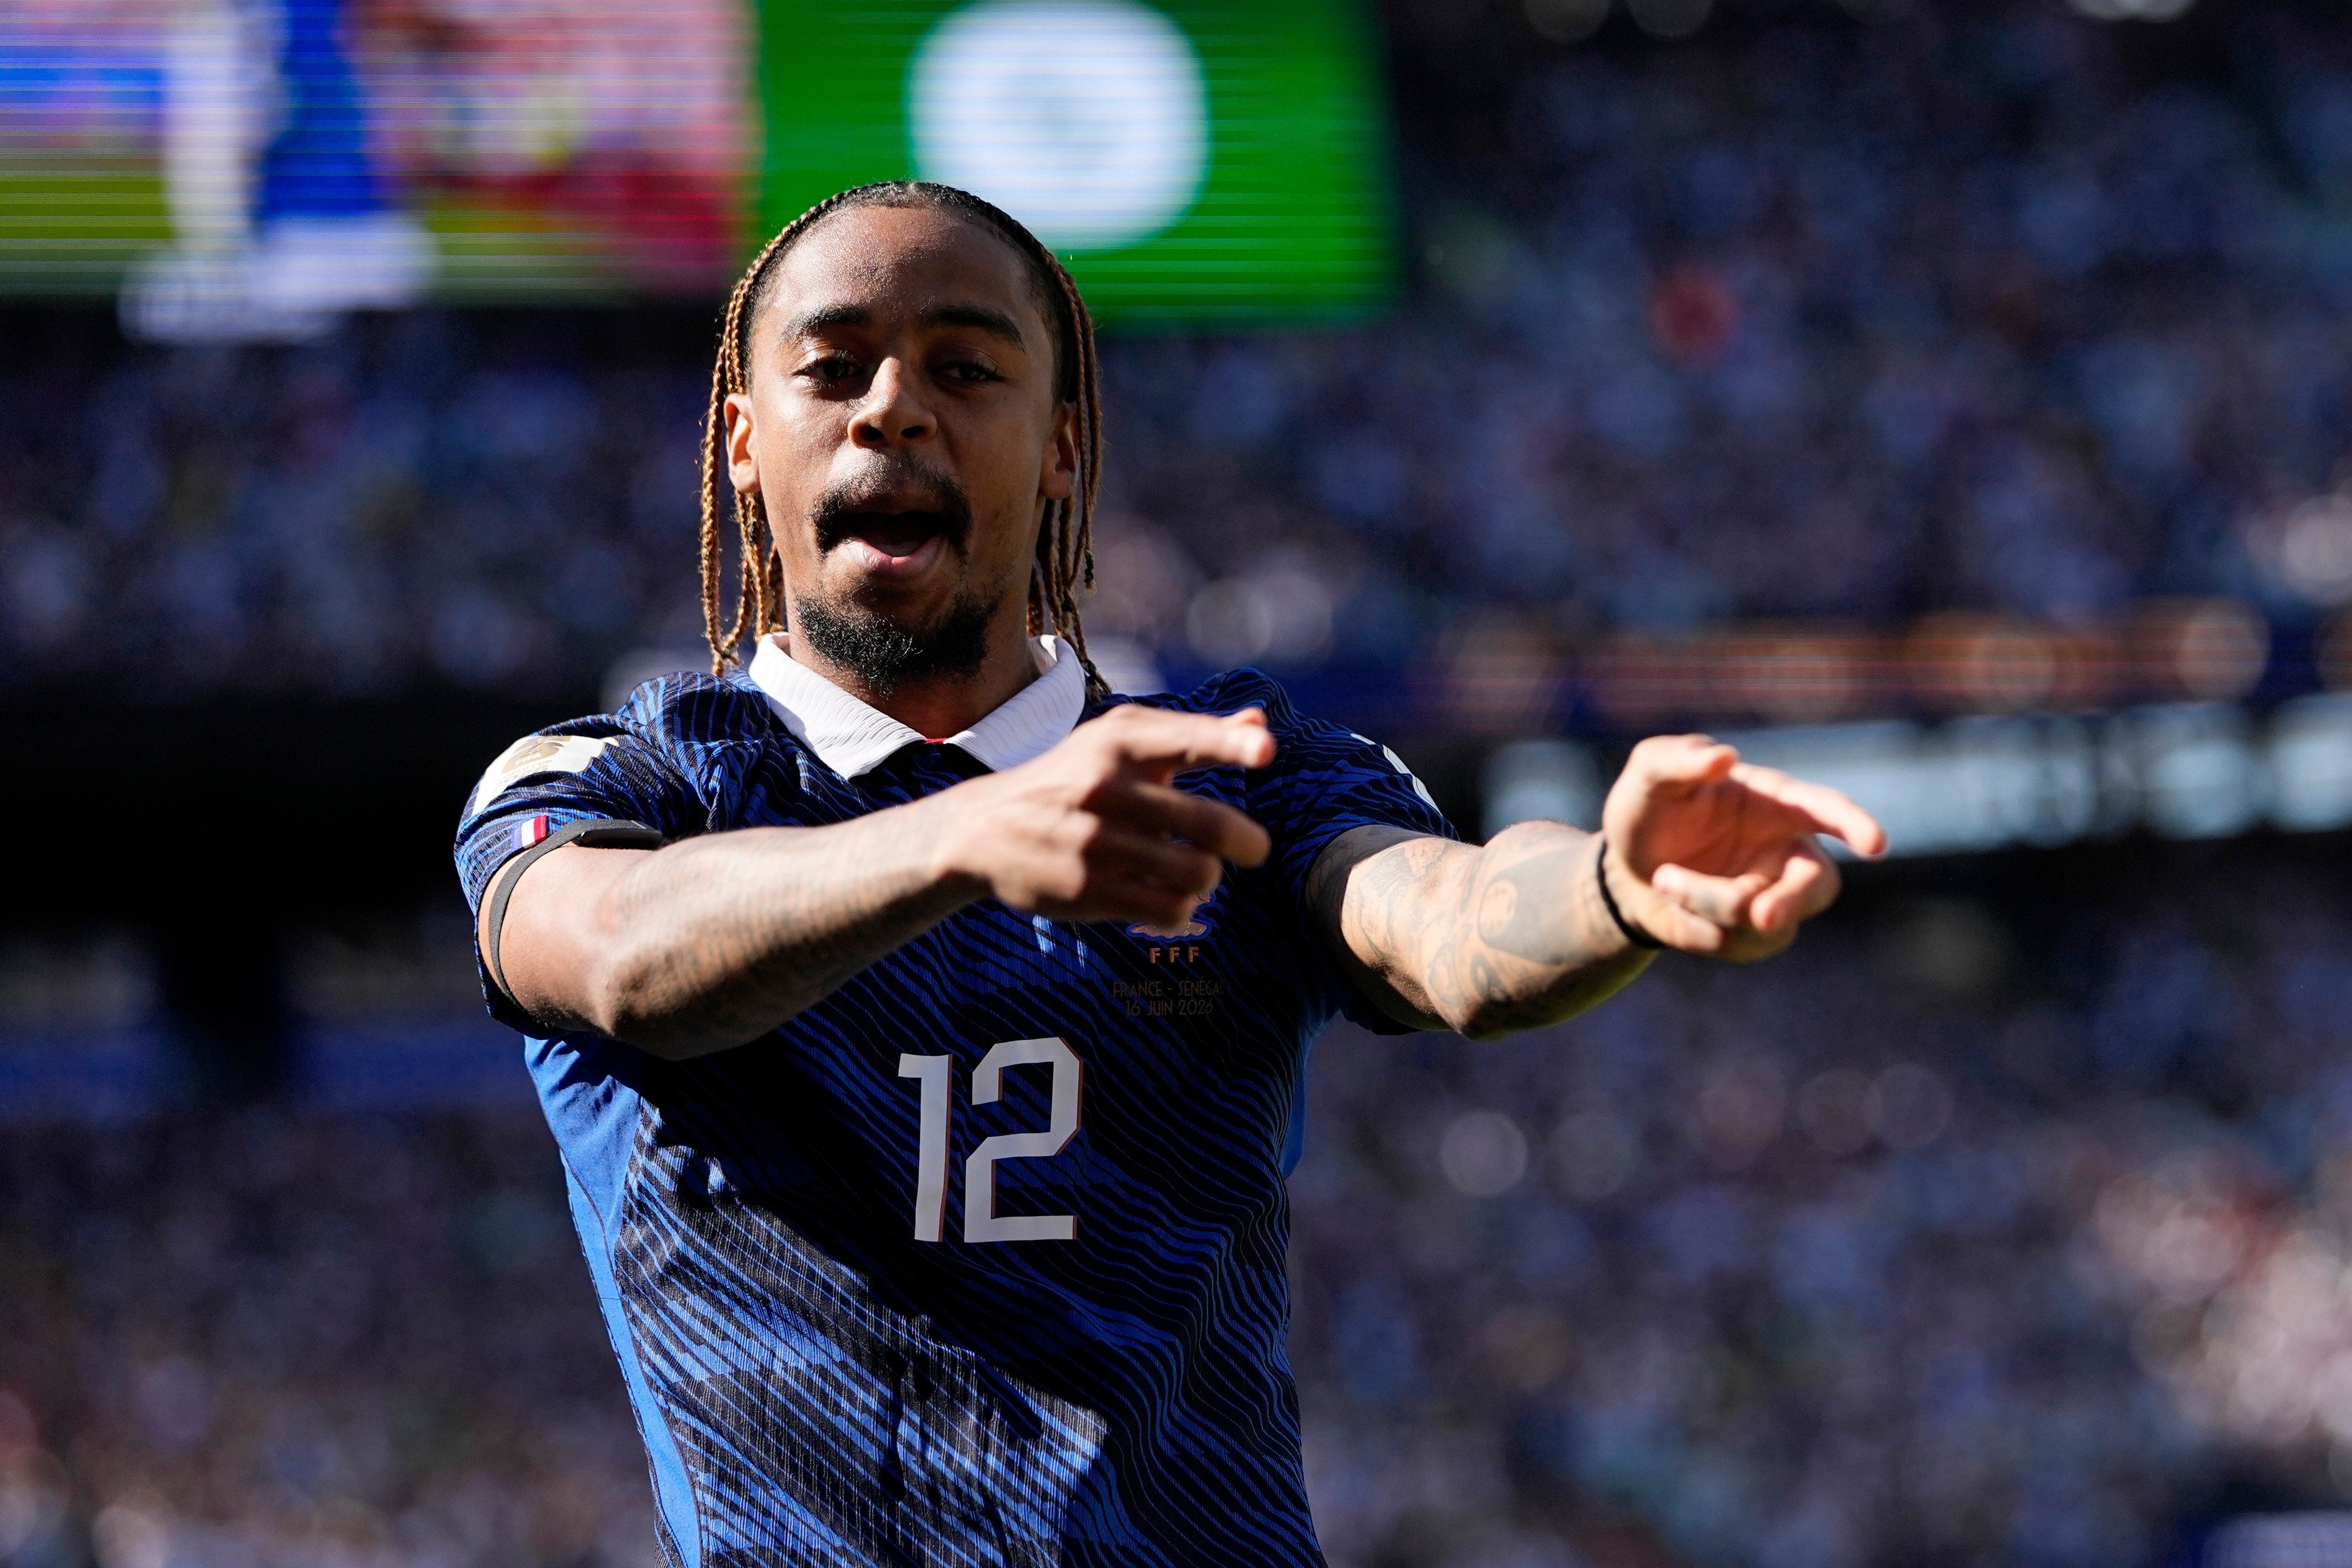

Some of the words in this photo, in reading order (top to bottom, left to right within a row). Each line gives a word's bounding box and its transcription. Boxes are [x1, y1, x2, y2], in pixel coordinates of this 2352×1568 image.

[531, 760, 553, 768] CUP
[1113, 981, 1162, 997] FRANCE
[1177, 976, 1224, 997] SÉNÉGAL
[1126, 999, 1140, 1016] 16
[1147, 999, 1173, 1016] JUIN
[1178, 998, 1213, 1016] 2026
[898, 1037, 1083, 1243] 12
